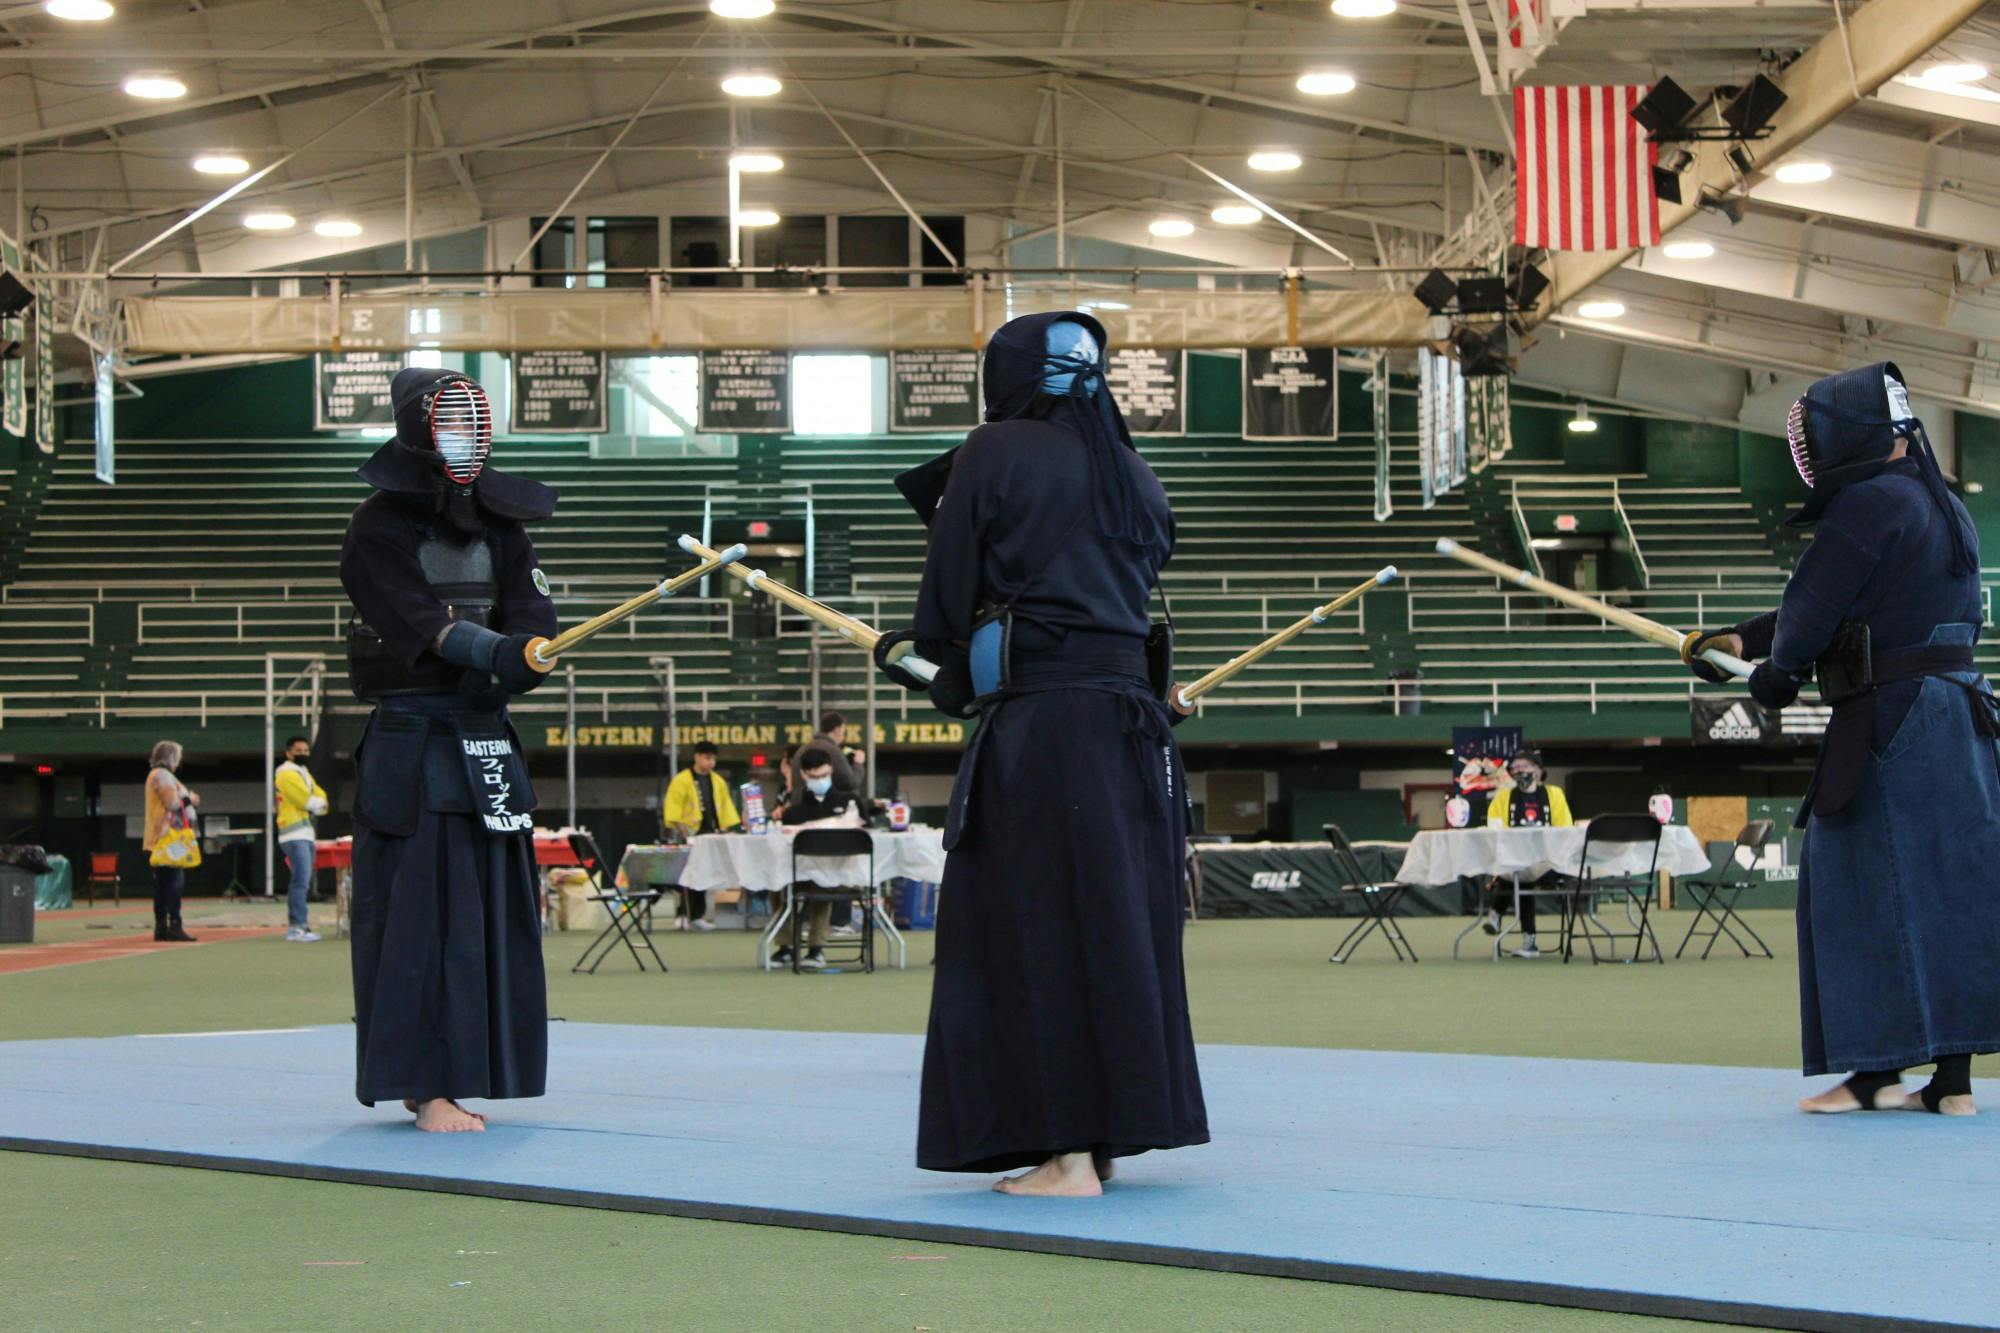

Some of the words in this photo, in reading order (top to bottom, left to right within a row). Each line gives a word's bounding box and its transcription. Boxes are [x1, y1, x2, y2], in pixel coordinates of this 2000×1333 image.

[1270, 351, 1308, 363] NCAA
[520, 366, 555, 376] TRACK
[568, 366, 598, 375] FIELD
[707, 366, 742, 375] TRACK
[336, 375, 390, 385] NATIONAL
[899, 373, 933, 382] TRACK
[945, 373, 975, 382] FIELD
[531, 380, 586, 389] NATIONAL
[719, 380, 772, 389] NATIONAL
[912, 385, 966, 394] NATIONAL
[1709, 715, 1761, 740] adidas
[546, 726, 653, 747] EASTERN
[894, 722, 963, 744] FIELD
[463, 739, 513, 757] EASTERN
[480, 758, 512, 816] フィロップス
[1250, 870, 1301, 891] GILL
